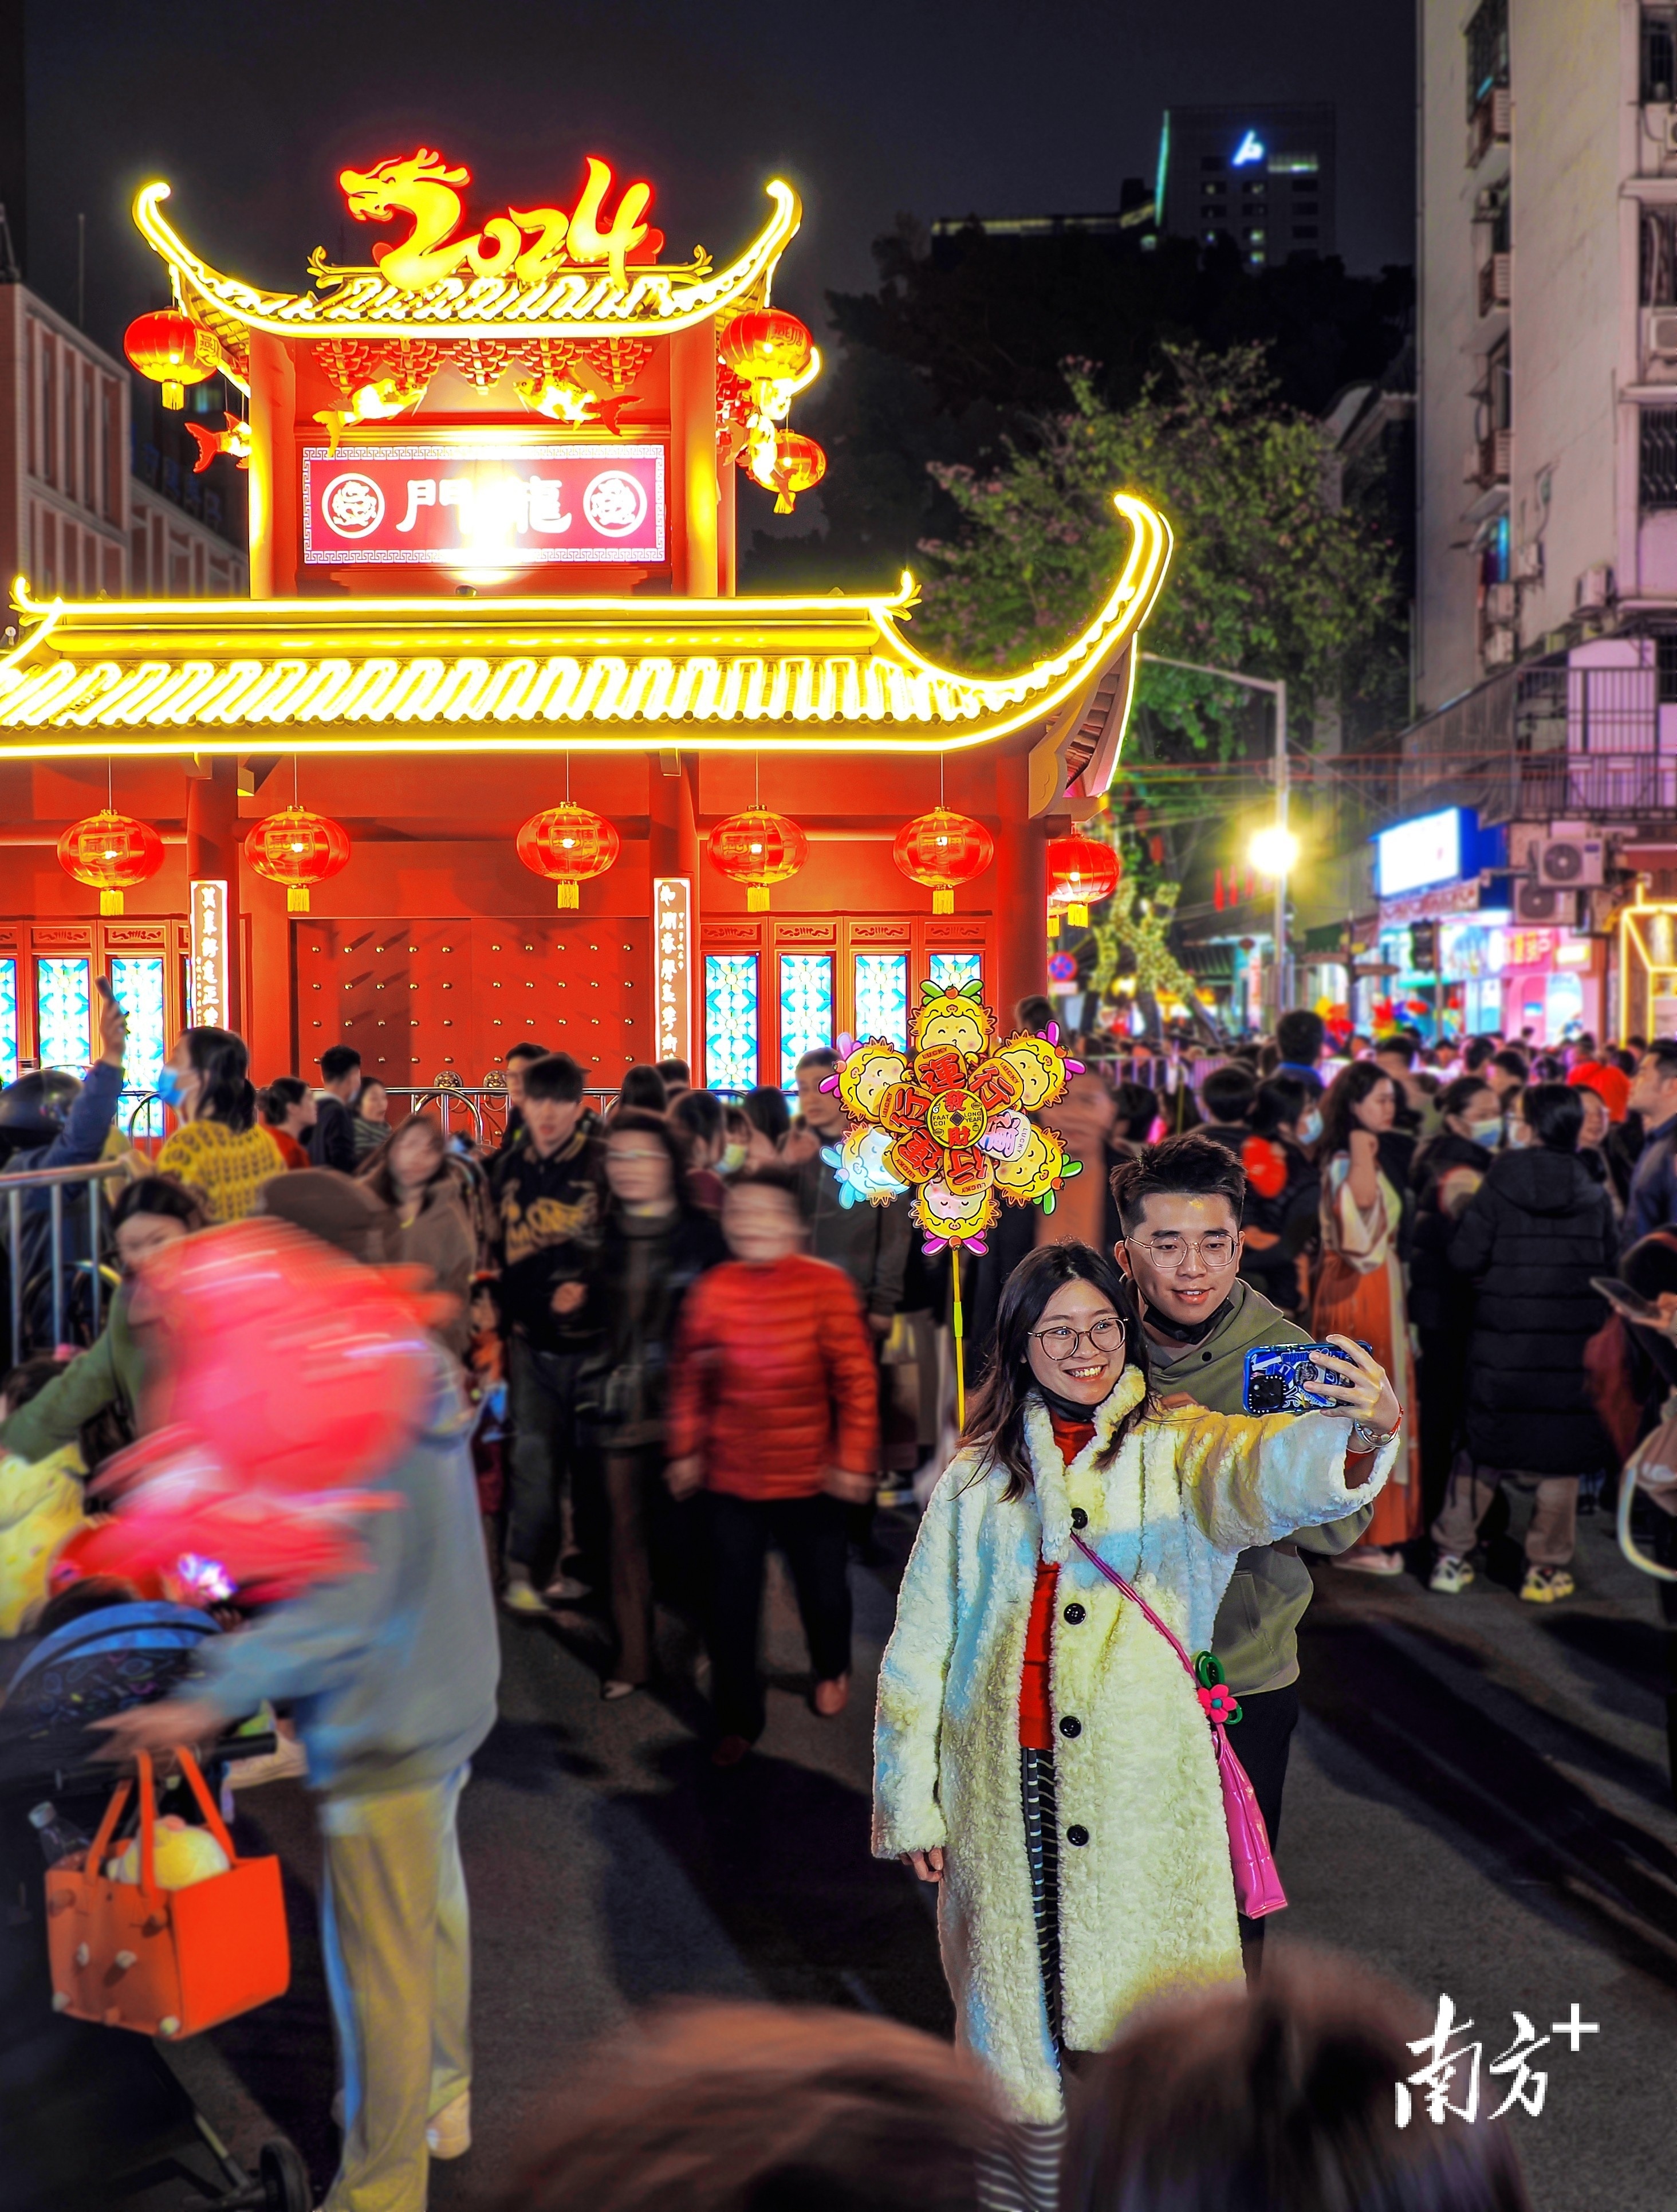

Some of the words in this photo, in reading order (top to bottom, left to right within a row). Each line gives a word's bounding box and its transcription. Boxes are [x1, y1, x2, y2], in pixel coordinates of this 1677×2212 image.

[339, 148, 651, 293] 2024
[922, 1047, 947, 1059] LUCKY
[918, 1053, 966, 1094] 運
[969, 1066, 1015, 1111] 行
[1000, 1062, 1019, 1084] LUCKY
[881, 1092, 892, 1118] LUCKY
[890, 1087, 932, 1130] 行
[898, 1127, 944, 1177] 運
[1017, 1128, 1028, 1154] LUCKY
[895, 1158, 915, 1179] LUCKY
[947, 1146, 987, 1185] 行
[962, 1182, 986, 1193] LUCKY
